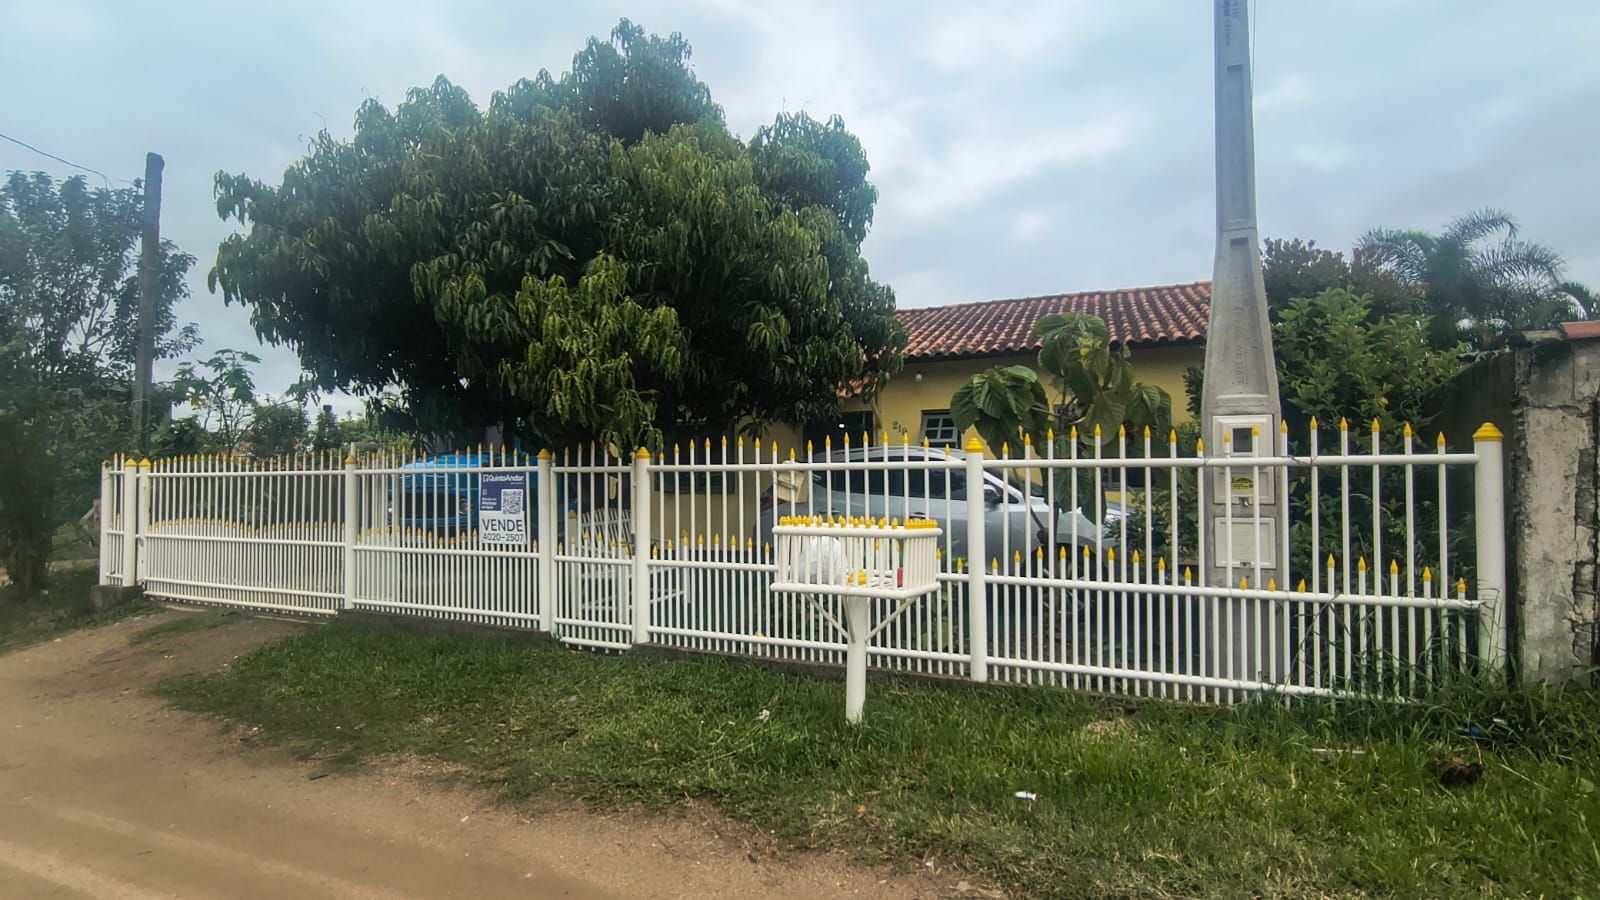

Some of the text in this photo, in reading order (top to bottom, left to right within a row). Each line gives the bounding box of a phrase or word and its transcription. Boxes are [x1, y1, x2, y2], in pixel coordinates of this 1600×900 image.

[490, 474, 525, 482] QuintoAndar
[481, 518, 523, 532] VENDE
[483, 532, 524, 542] 4020-2507
